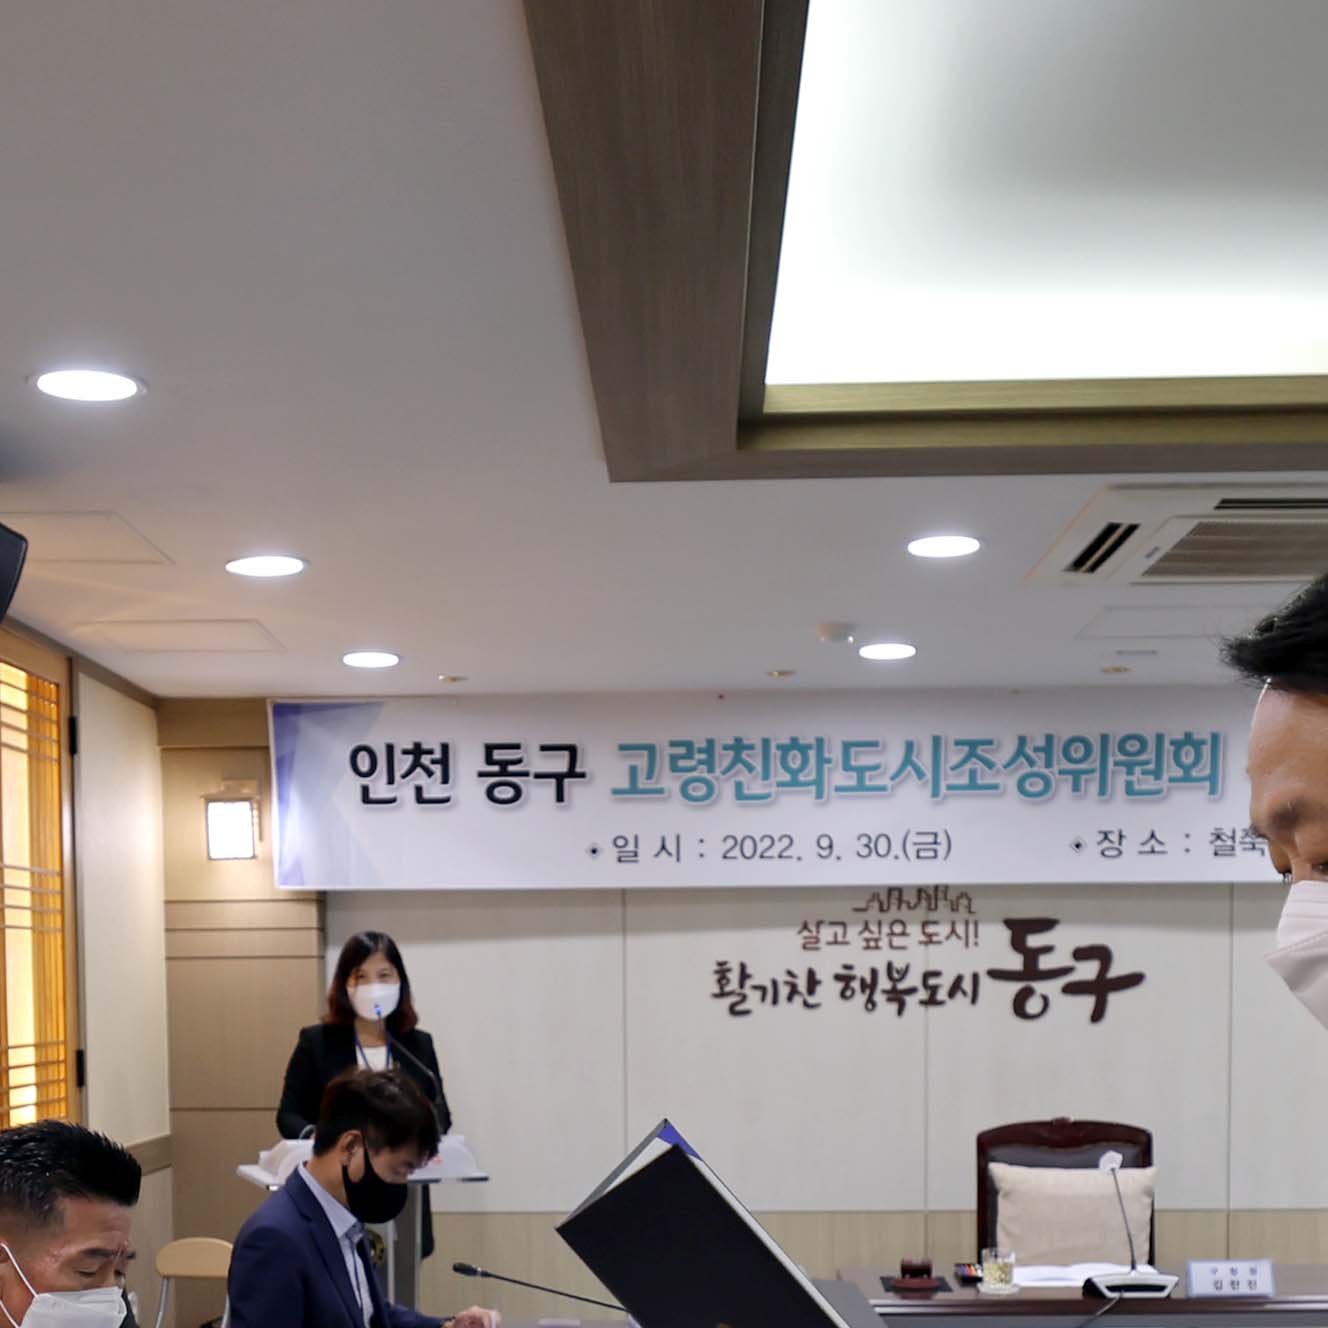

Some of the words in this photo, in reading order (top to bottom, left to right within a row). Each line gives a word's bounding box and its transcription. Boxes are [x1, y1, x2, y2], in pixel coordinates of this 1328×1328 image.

[349, 740, 452, 805] 인천
[477, 741, 587, 804] 동구
[611, 731, 1220, 802] 고령친화도시조성위원회
[721, 833, 803, 862] 2022.
[816, 833, 843, 862] 9.
[856, 829, 952, 863] 30.(금)
[796, 919, 850, 951] 살고
[858, 919, 910, 951] 싶은
[918, 918, 980, 950] 도시!
[711, 959, 823, 1017] 활기찬
[833, 960, 981, 1017] 행복도시
[985, 916, 1146, 1024] 동구
